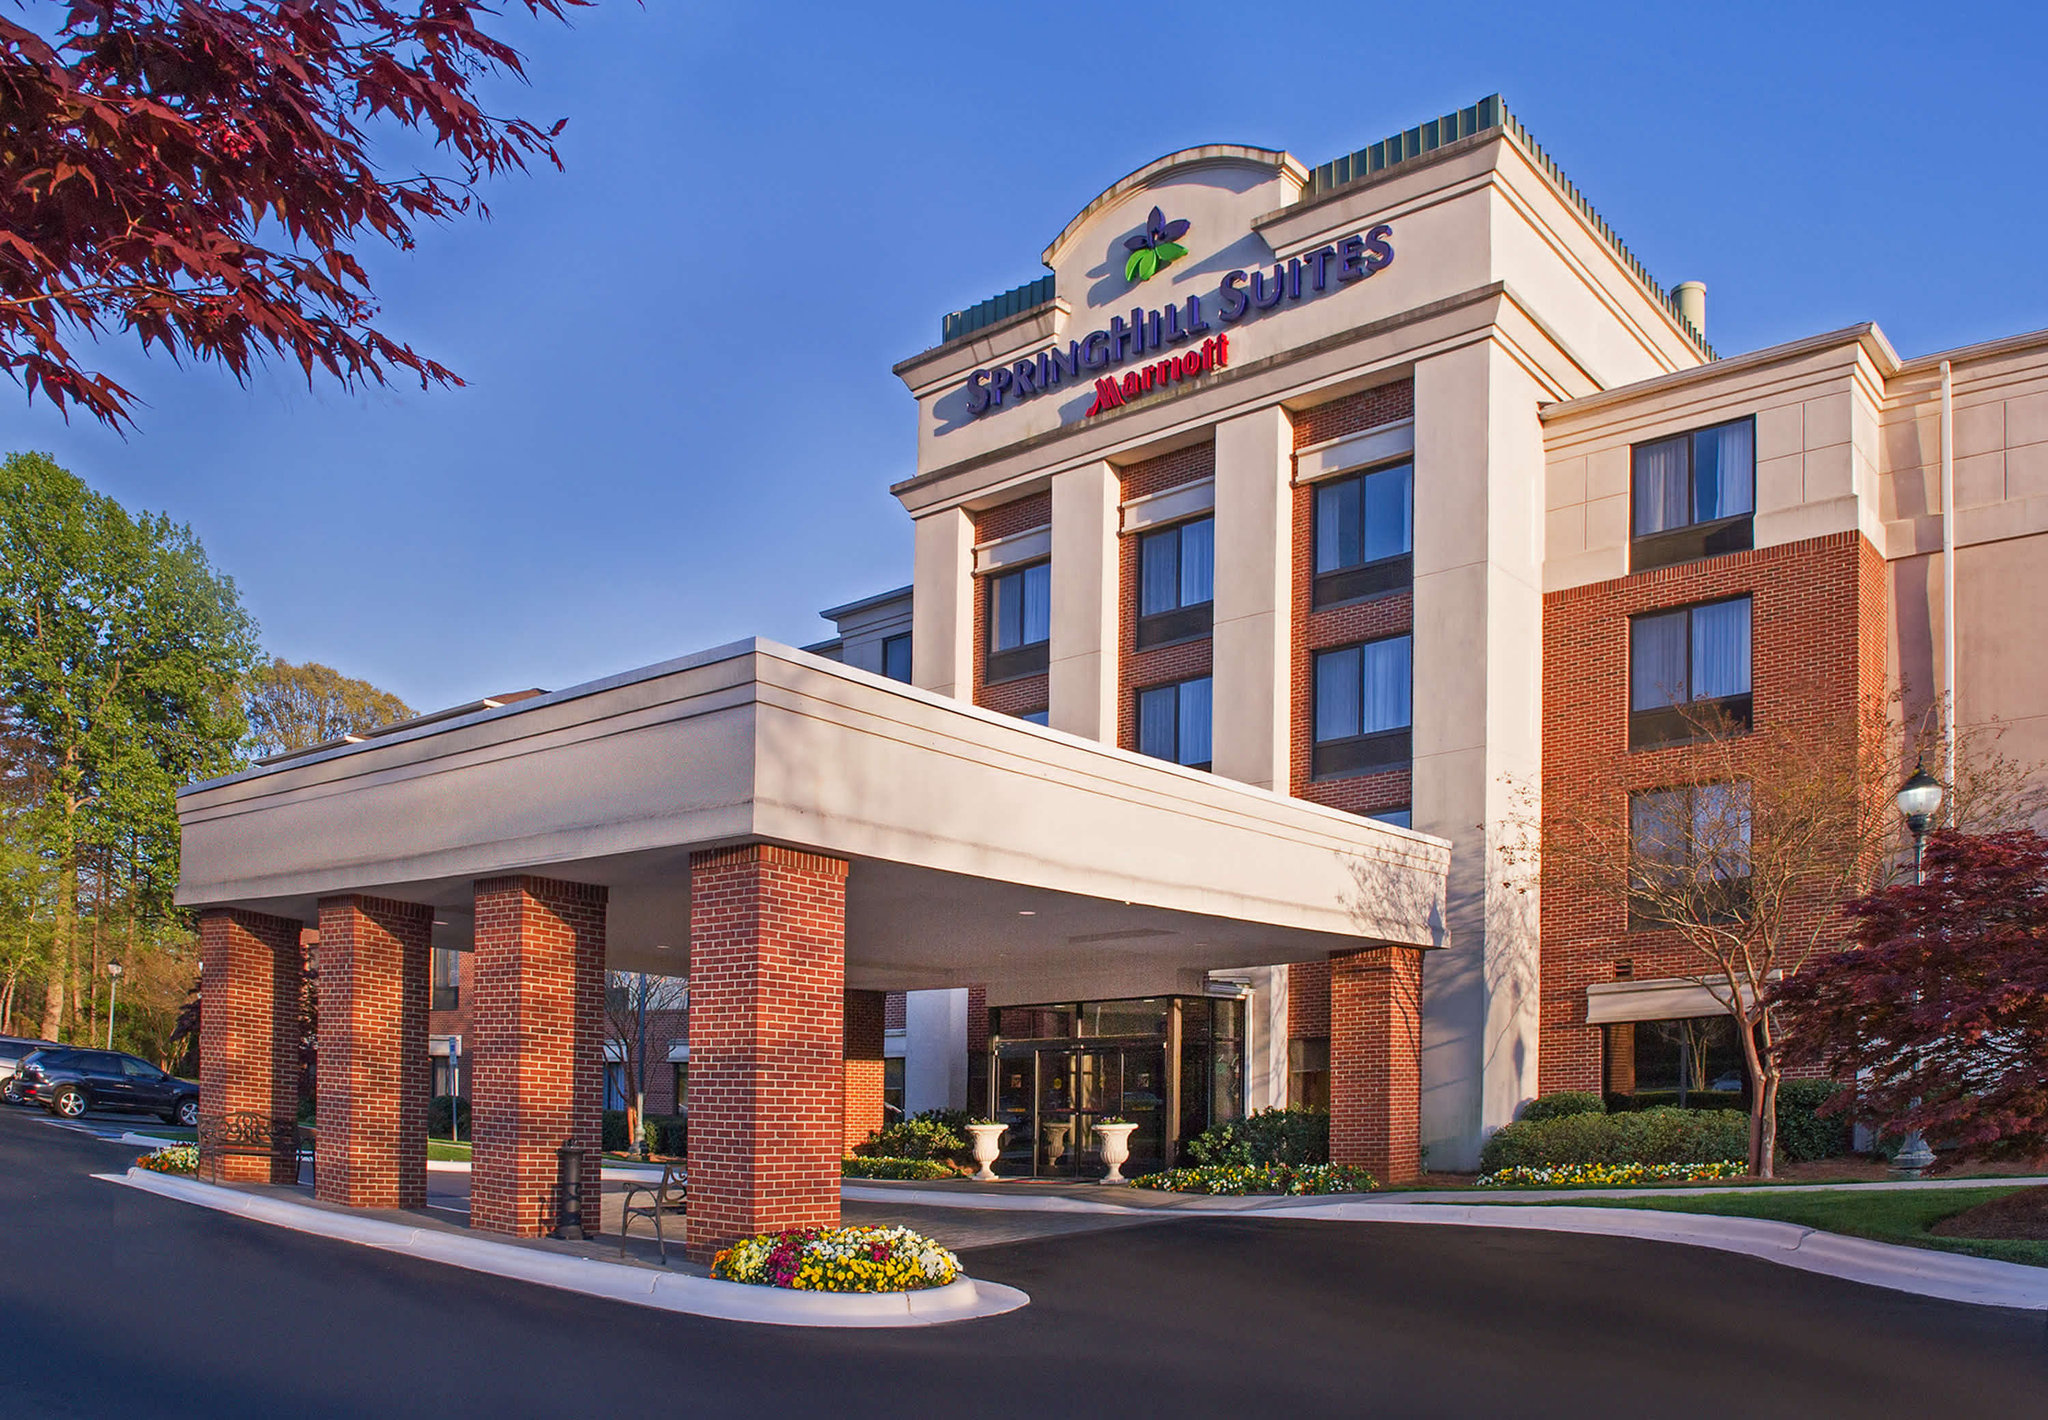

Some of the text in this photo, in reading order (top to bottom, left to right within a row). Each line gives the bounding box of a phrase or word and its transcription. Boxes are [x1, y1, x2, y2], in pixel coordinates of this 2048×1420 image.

[967, 225, 1395, 415] SPRINGHILL SUITES
[1085, 333, 1229, 416] Marriott
